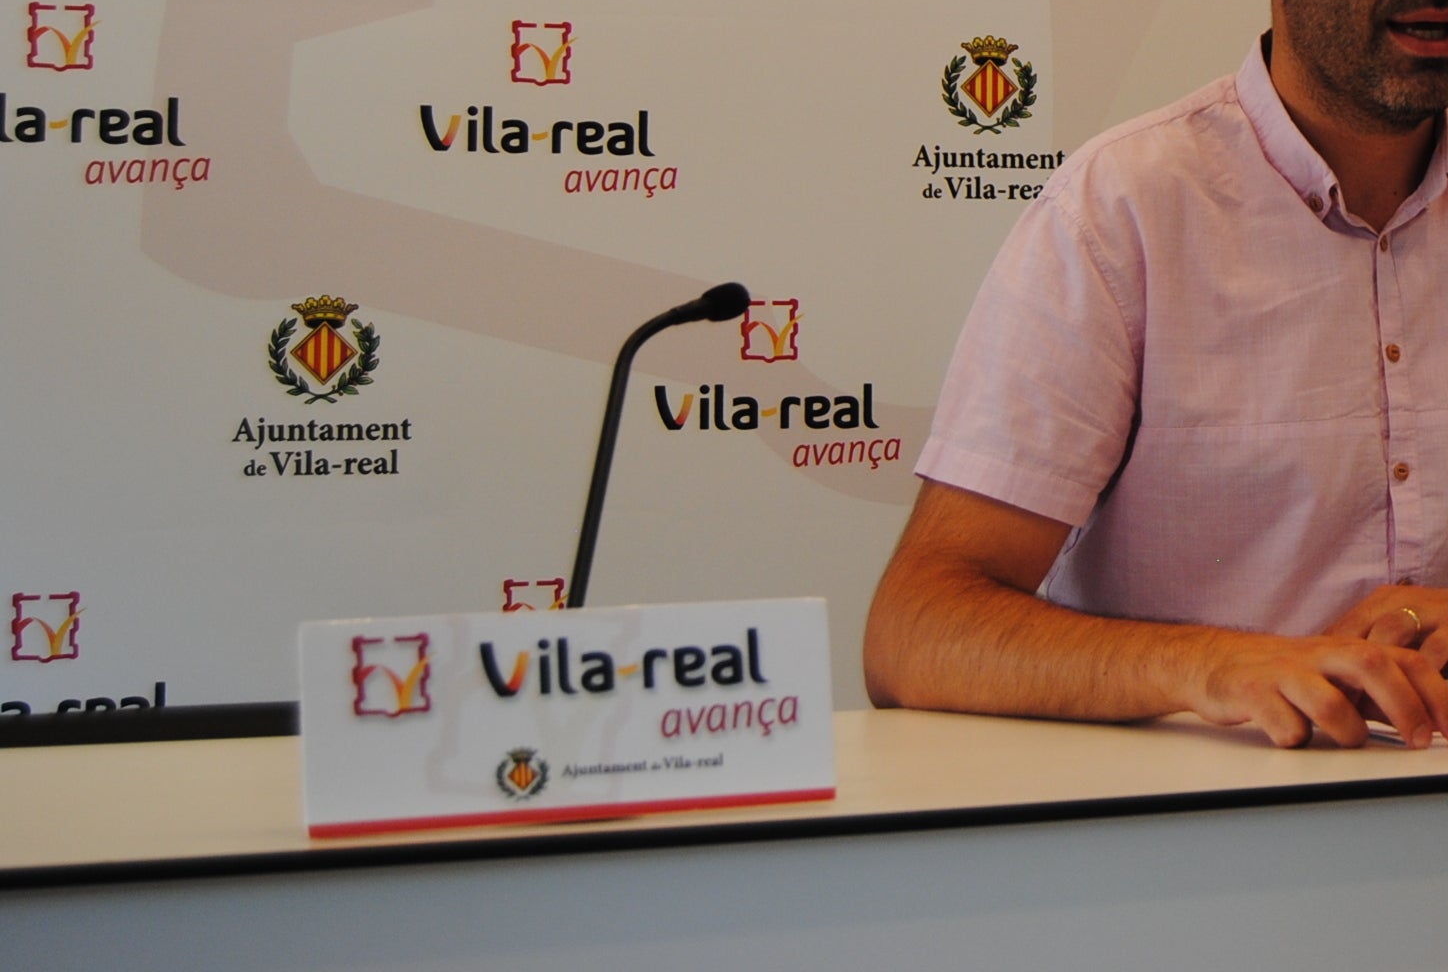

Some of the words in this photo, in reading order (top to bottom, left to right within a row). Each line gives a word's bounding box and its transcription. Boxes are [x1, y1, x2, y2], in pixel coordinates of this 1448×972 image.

[419, 104, 655, 157] Vila-real
[84, 157, 211, 191] avança
[912, 144, 1066, 175] Ajuntament
[564, 167, 678, 199] avança
[922, 183, 943, 199] de
[943, 175, 1046, 201] Vila-rea
[654, 383, 879, 431] Vila-real
[231, 417, 412, 449] Ajuntament
[243, 459, 267, 477] de
[269, 448, 399, 476] Vila-real
[792, 438, 901, 470] avança
[479, 627, 768, 698] Vila-real
[660, 695, 798, 738] avança
[561, 760, 648, 779] Ajuntament
[662, 752, 725, 770] Vila-real
